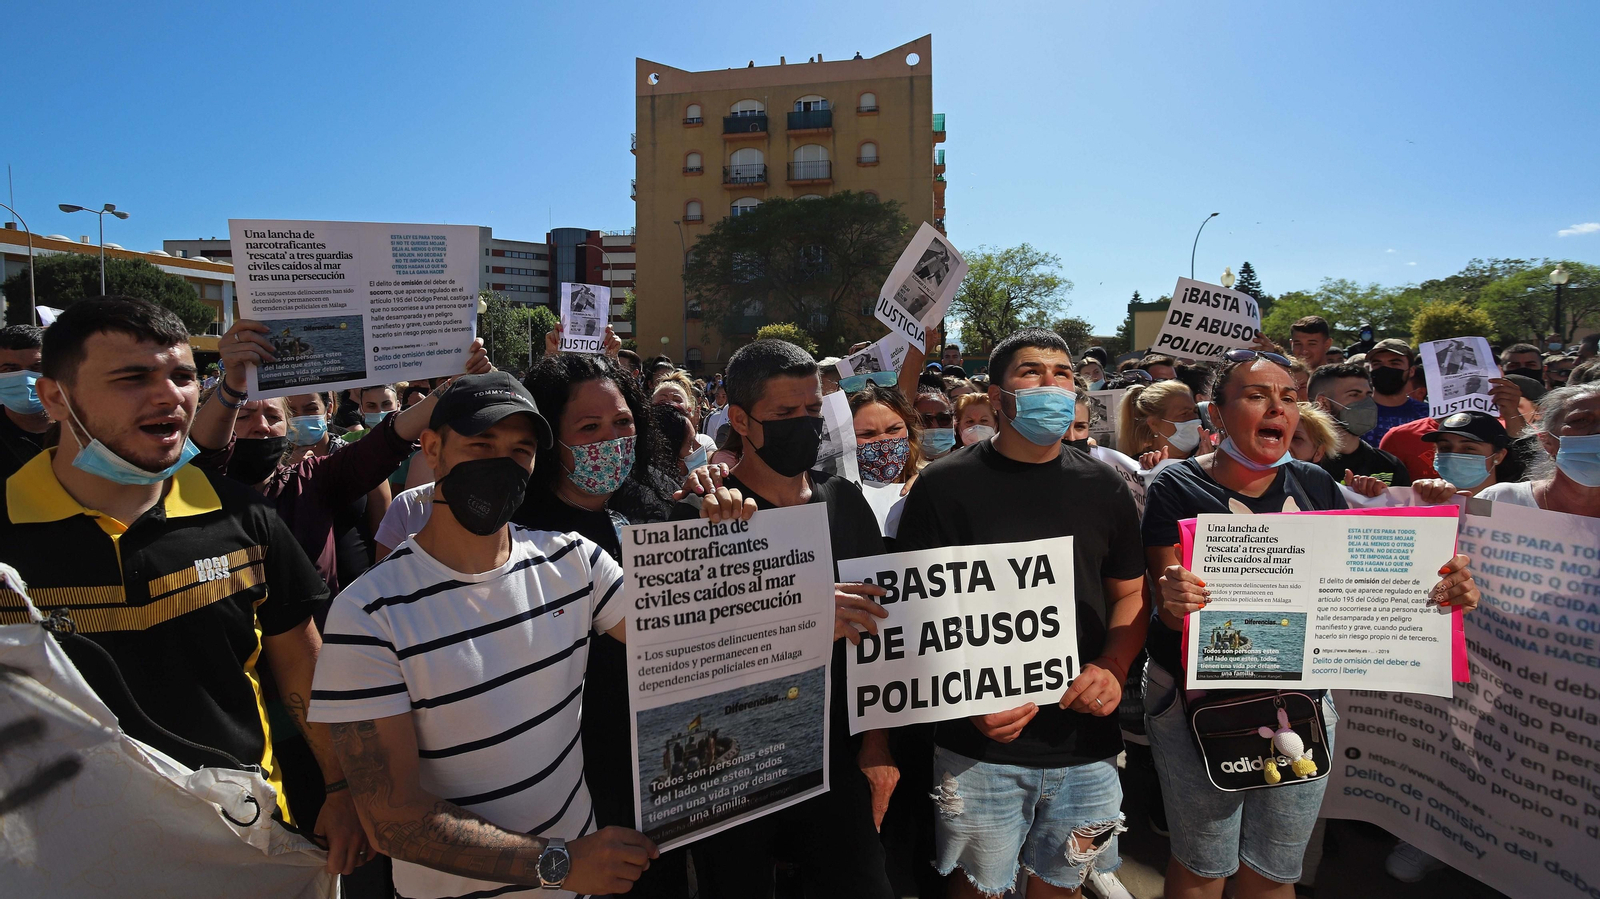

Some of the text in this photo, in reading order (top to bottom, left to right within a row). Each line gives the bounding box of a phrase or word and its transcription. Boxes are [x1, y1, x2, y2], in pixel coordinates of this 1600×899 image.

[244, 230, 314, 238] Una lancha de
[246, 240, 326, 249] narcotraficantes
[248, 262, 280, 270] civiles
[316, 251, 353, 261] guardias
[292, 272, 345, 282] persecución
[1182, 287, 1258, 320] ¡BASTA YA
[878, 298, 925, 347] JUSTICIA
[1169, 310, 1194, 328] DE
[375, 363, 398, 371] socorro
[1433, 398, 1500, 417] JUSTICIA
[632, 519, 748, 545] Una lancha de
[1206, 535, 1278, 543] narcotraficantes
[1208, 524, 1269, 533] Una lancha de
[1459, 524, 1565, 554] LEY ES PARA
[633, 537, 769, 567] narcotraficantes
[707, 567, 717, 579] a
[720, 561, 750, 577] tres
[753, 549, 815, 575] guardias
[1204, 555, 1232, 563] civiles
[1234, 555, 1262, 563] caídos
[1263, 556, 1271, 564] al
[1267, 545, 1305, 555] guardias
[198, 567, 230, 582] BOSS
[1007, 554, 1055, 589] YA
[1203, 565, 1220, 573] tras
[1240, 566, 1294, 575] persecución
[635, 572, 796, 610] civiles caídos al mar
[636, 590, 802, 632] tras una persecución
[645, 620, 816, 661] Los supuestos delincuentes han sido
[856, 606, 1060, 664] DE ABUSOS
[638, 643, 772, 677] detenidos y permanecen en
[639, 649, 802, 691] dependencias policiales en Málaga
[857, 656, 1074, 717] POLICIALES!
[651, 743, 785, 792] Todos son personas esten
[654, 792, 671, 806] del
[675, 784, 698, 799] lado
[701, 778, 720, 793] que
[755, 756, 782, 770] todos
[1347, 720, 1579, 830] hacerlo sin riesgo propio ni
[648, 805, 684, 823] tienen
[687, 797, 706, 809] una
[708, 789, 730, 801] vida
[733, 782, 749, 796] por
[752, 768, 787, 786] delante
[1344, 786, 1410, 817] socorro
[690, 811, 709, 823] una
[1345, 765, 1600, 899] Delito de omisión del debe
